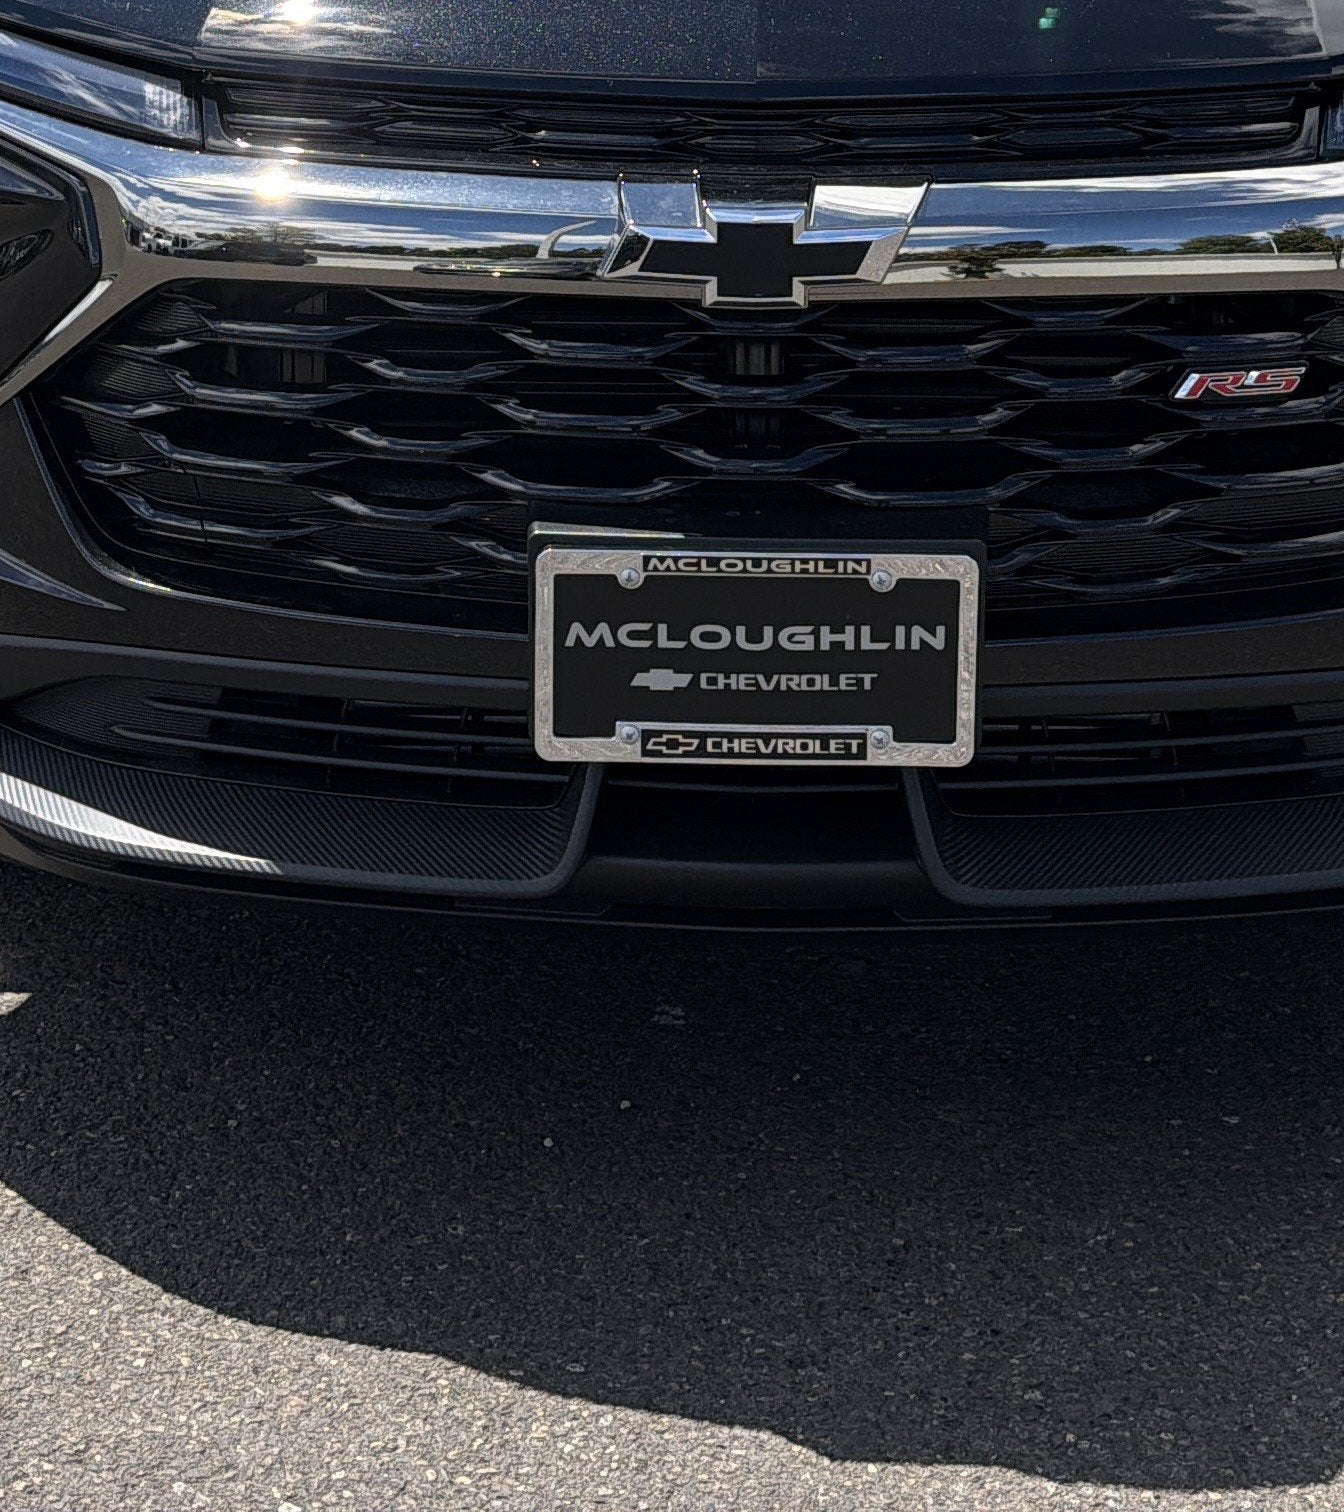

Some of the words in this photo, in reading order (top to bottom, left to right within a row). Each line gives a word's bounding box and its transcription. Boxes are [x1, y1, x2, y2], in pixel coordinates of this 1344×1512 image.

[1174, 366, 1307, 400] RS
[647, 557, 867, 574] MCLOUGHLIN
[564, 621, 946, 651] MCLOUGHLIN
[700, 672, 879, 691] CHEVROLET
[706, 737, 863, 755] CHEVROLET
